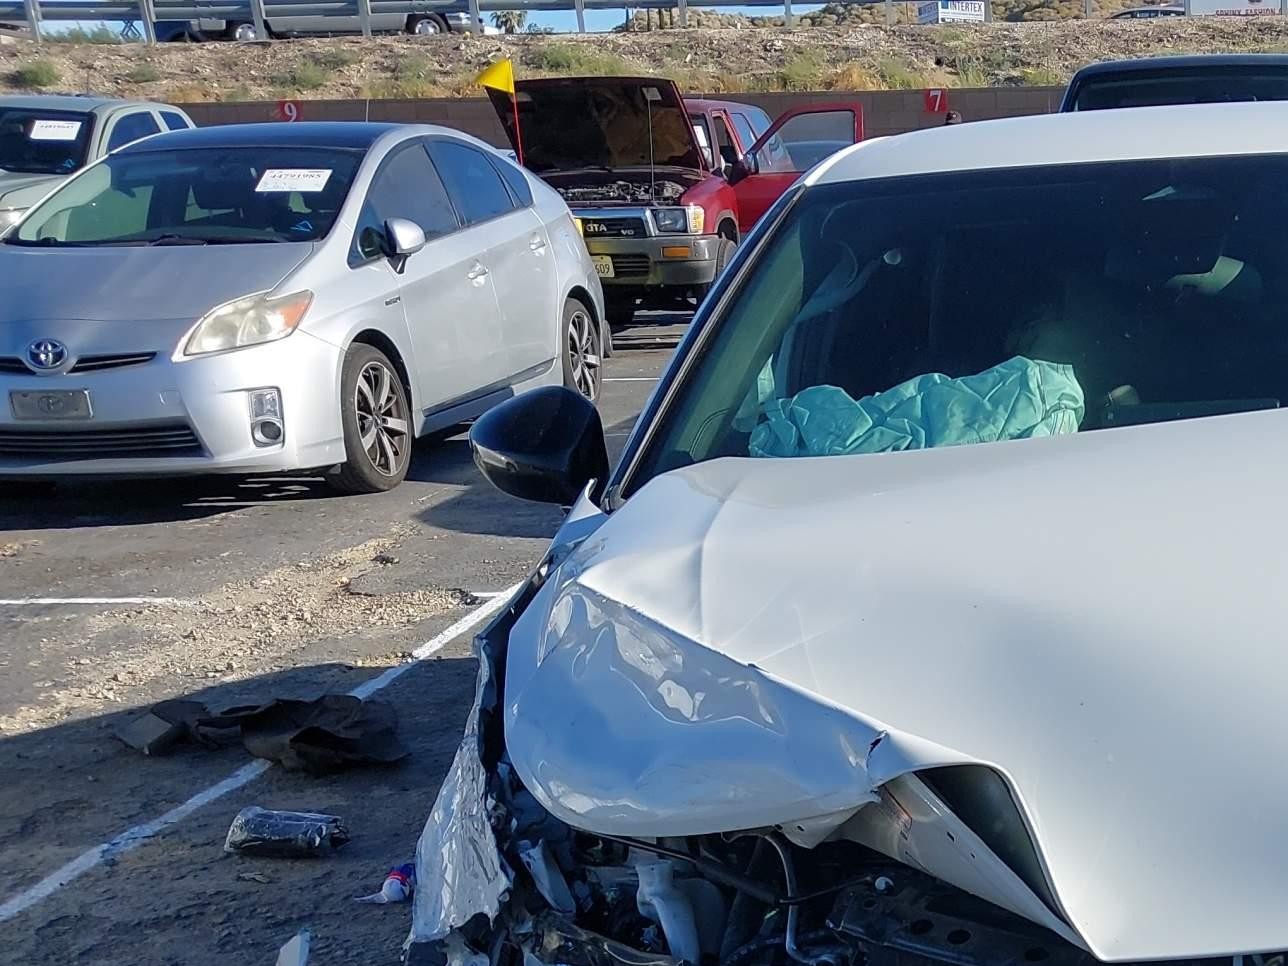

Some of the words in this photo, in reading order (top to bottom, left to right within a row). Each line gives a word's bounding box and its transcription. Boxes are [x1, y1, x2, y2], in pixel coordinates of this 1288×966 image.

[929, 90, 942, 111] 7
[284, 102, 297, 122] 9
[585, 223, 607, 232] OTA
